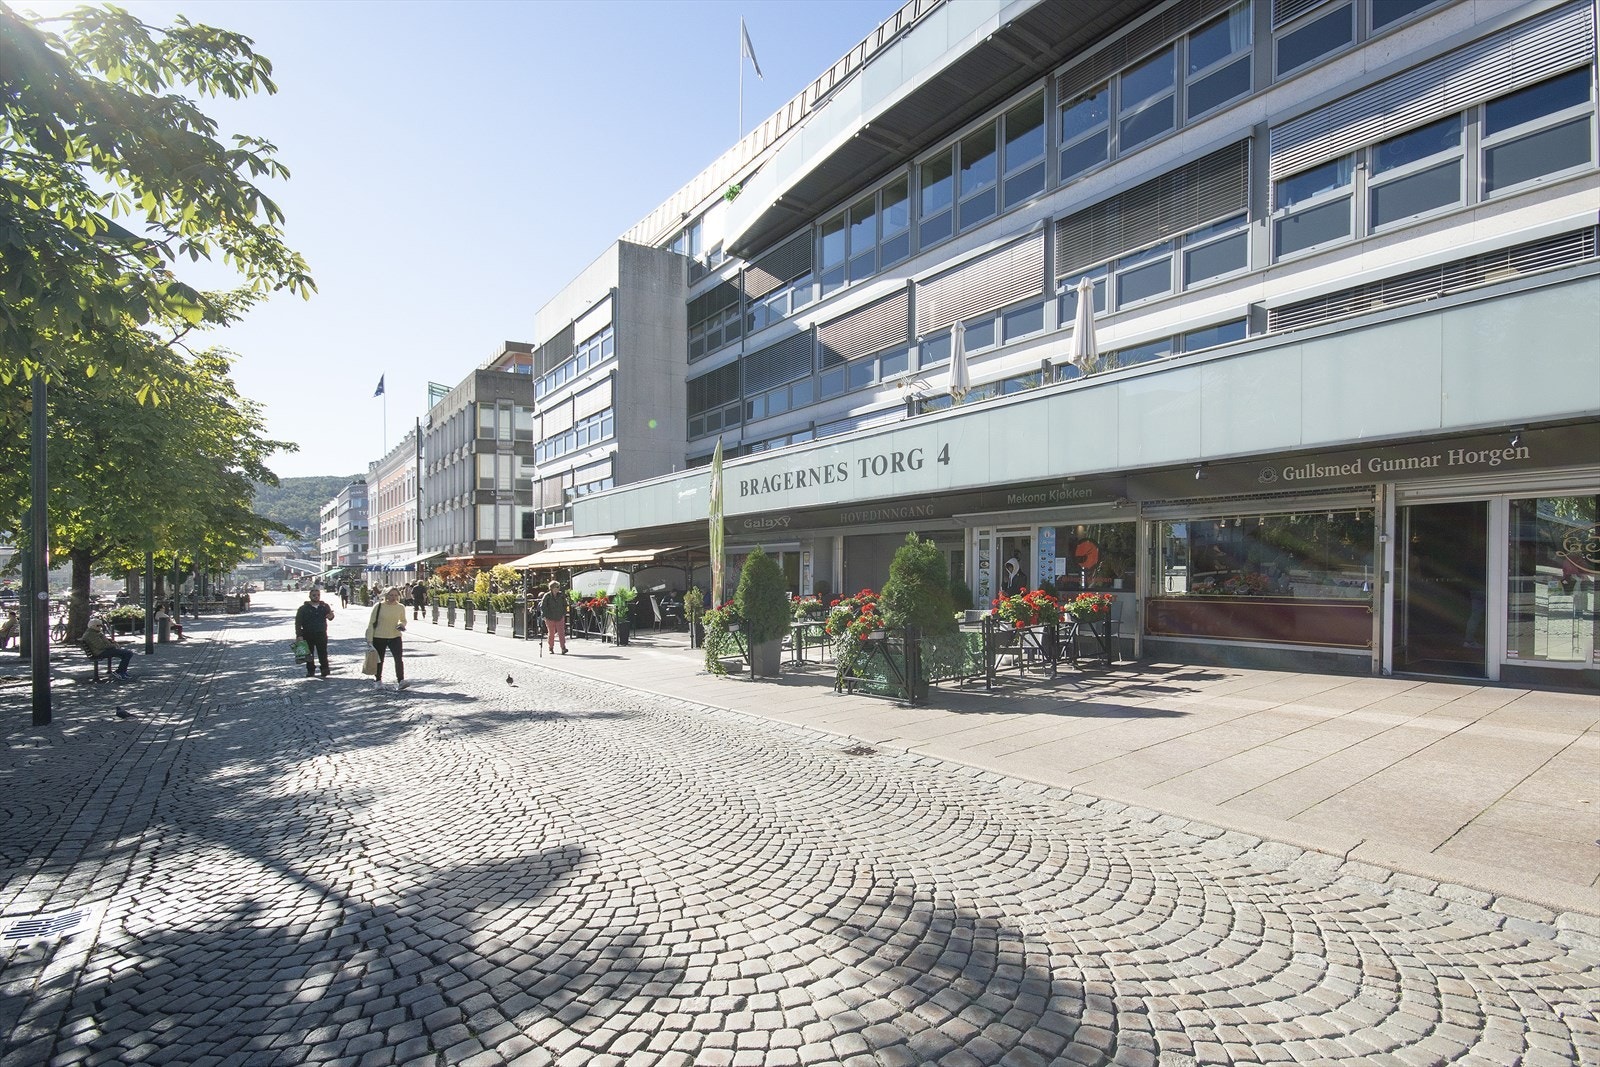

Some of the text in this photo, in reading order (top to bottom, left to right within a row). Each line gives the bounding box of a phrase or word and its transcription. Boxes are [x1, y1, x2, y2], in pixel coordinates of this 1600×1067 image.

[739, 442, 951, 497] BRAGERNES TORG 4
[1282, 445, 1531, 481] Gullsmed Gunnar Horgen
[1007, 487, 1093, 505] Mekong Kjøkken
[743, 515, 792, 530] Galaxy
[840, 504, 935, 524] HOVEDINNGANG
